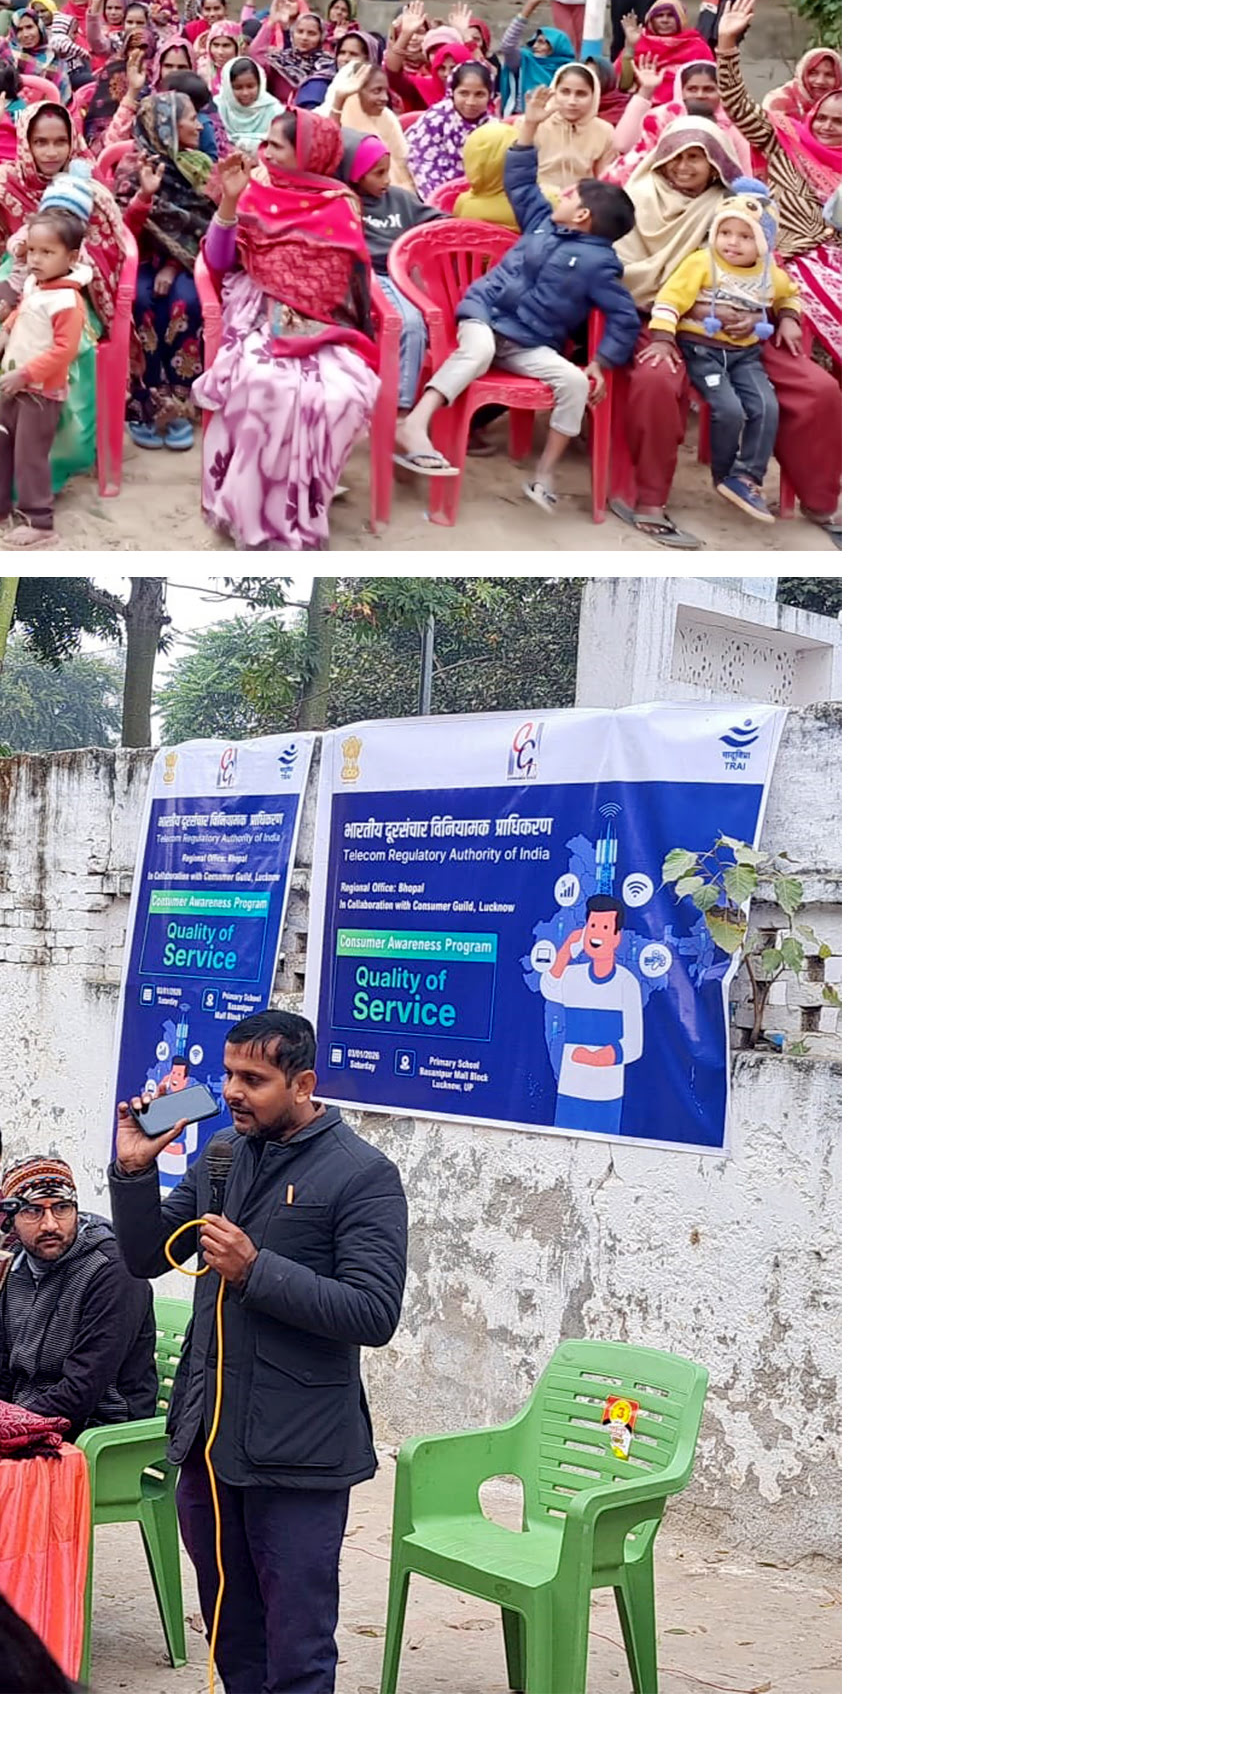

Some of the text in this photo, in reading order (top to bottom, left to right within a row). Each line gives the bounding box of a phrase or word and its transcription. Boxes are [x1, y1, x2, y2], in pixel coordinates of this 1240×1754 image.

[724, 761, 747, 771] TRAI
[344, 814, 553, 843] भारतीय दूरसंचार विनियामक प्राधिकरण
[157, 833, 280, 845] Telecom Regulatory Authority of India
[343, 846, 550, 864] Telecom Regulatory Authority of India
[203, 872, 235, 882] Consumer
[340, 882, 424, 894] Regional Office: Bhopal
[151, 895, 268, 912] Consumer Awareness Program
[339, 900, 515, 913] In Collaboration with Consumer Guild, Lucknow
[167, 922, 235, 945] Quality of
[340, 934, 492, 955] Consumer Awareness Program
[163, 942, 237, 970] Service
[355, 966, 448, 994] Quality of
[353, 992, 456, 1027] Service
[429, 1056, 480, 1070] Primary School
[470, 1071, 488, 1082] Block
[463, 1082, 474, 1092] UP
[616, 1407, 625, 1419] 3
